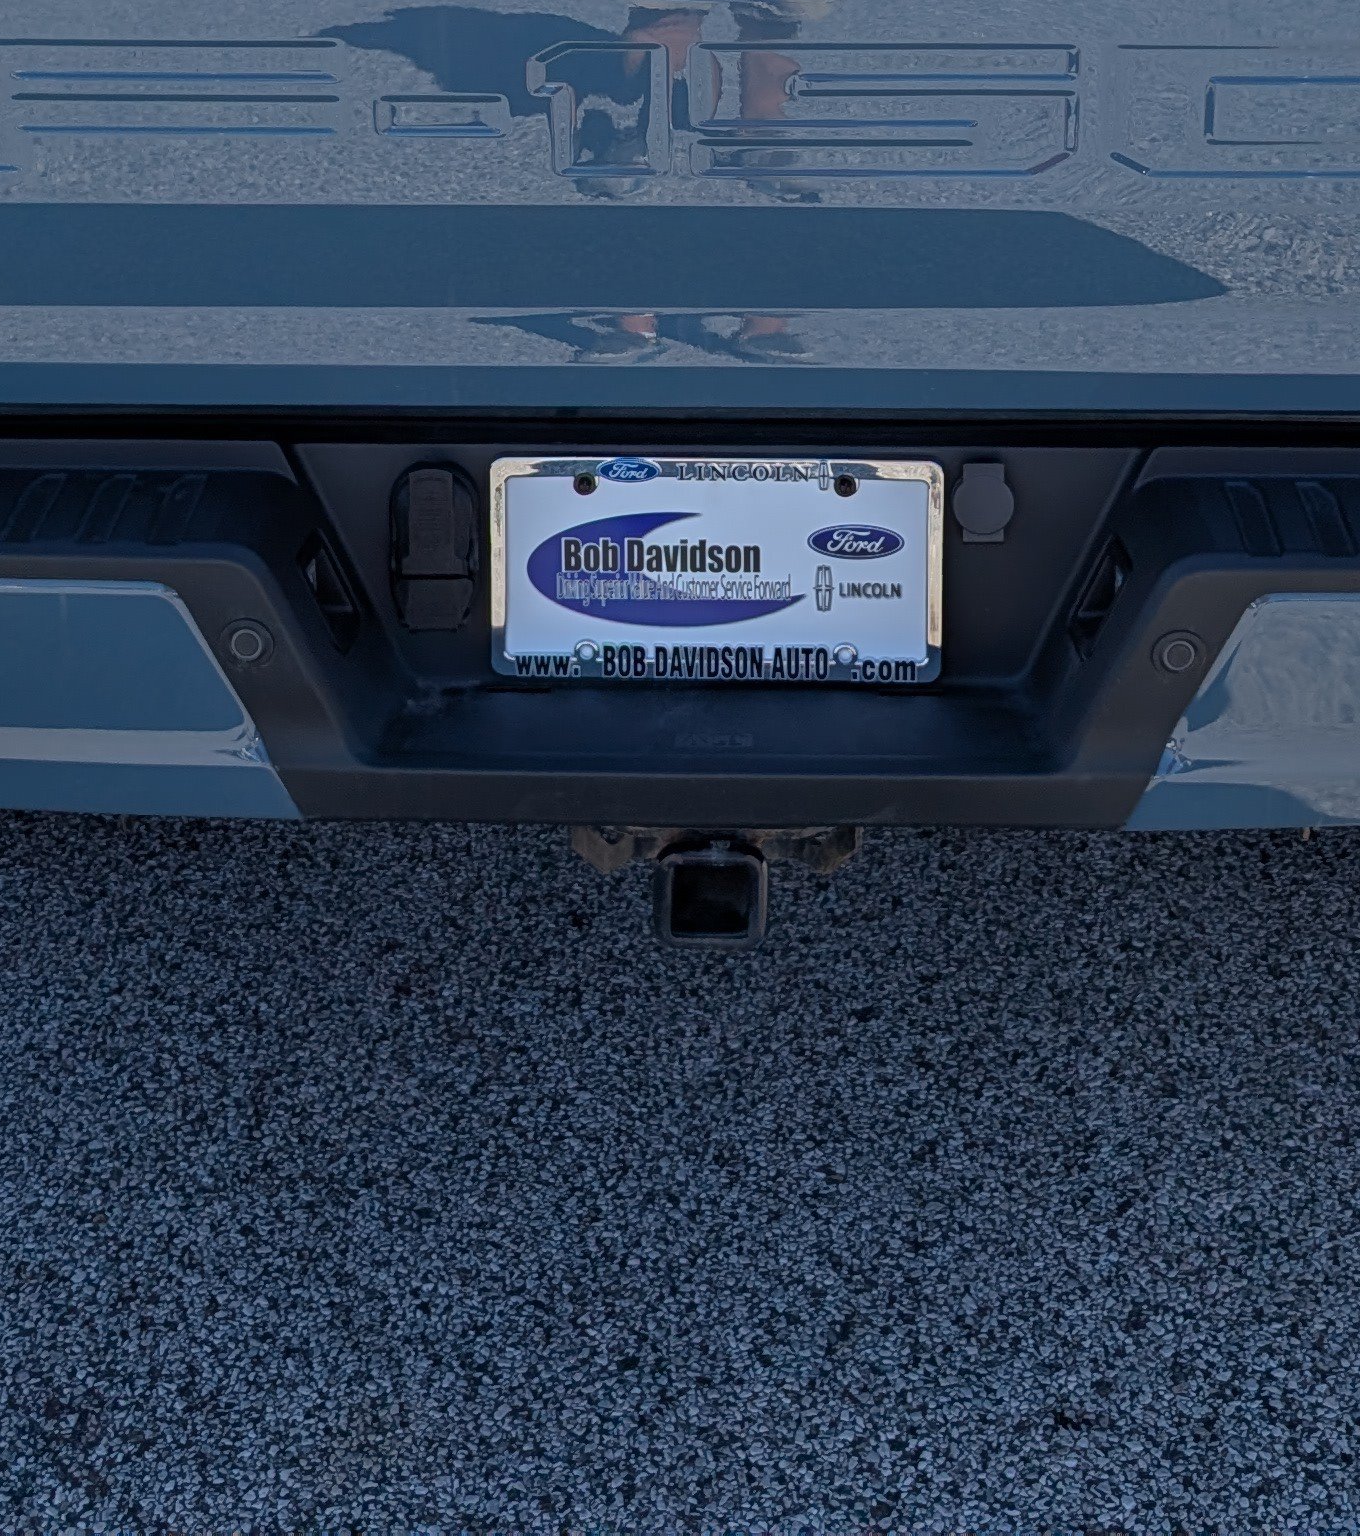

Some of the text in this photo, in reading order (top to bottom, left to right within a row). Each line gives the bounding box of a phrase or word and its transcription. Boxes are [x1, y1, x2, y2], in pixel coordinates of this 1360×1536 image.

[608, 462, 649, 481] Ford
[676, 462, 811, 482] LINCOLN
[825, 530, 885, 554] Ford
[563, 537, 762, 573] Bob Davidson
[656, 573, 675, 600] And
[675, 574, 721, 600] Customer
[721, 574, 754, 600] Service
[754, 574, 792, 601] Forward
[838, 581, 902, 600] LINCOLN
[514, 644, 917, 682] www. BOB DAVIDSON AUTO .com
